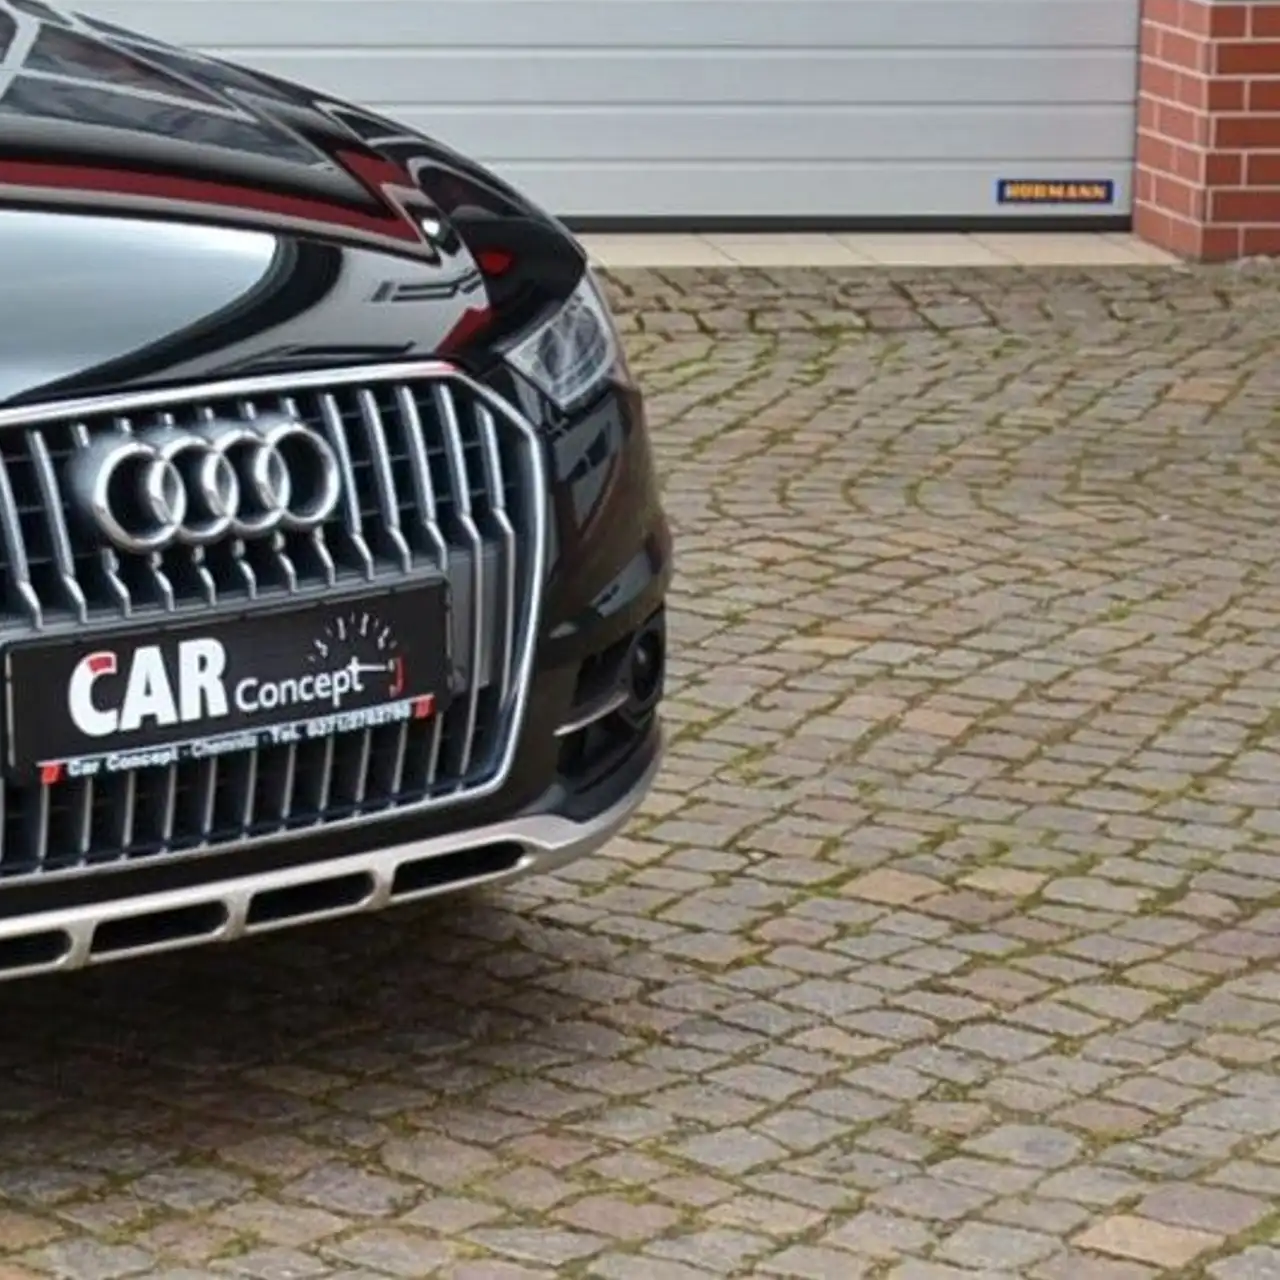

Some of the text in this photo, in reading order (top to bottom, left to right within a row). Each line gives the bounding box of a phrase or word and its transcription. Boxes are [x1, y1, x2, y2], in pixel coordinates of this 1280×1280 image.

[68, 636, 229, 736] CAR
[234, 656, 365, 706] Concept
[68, 758, 100, 777] Car
